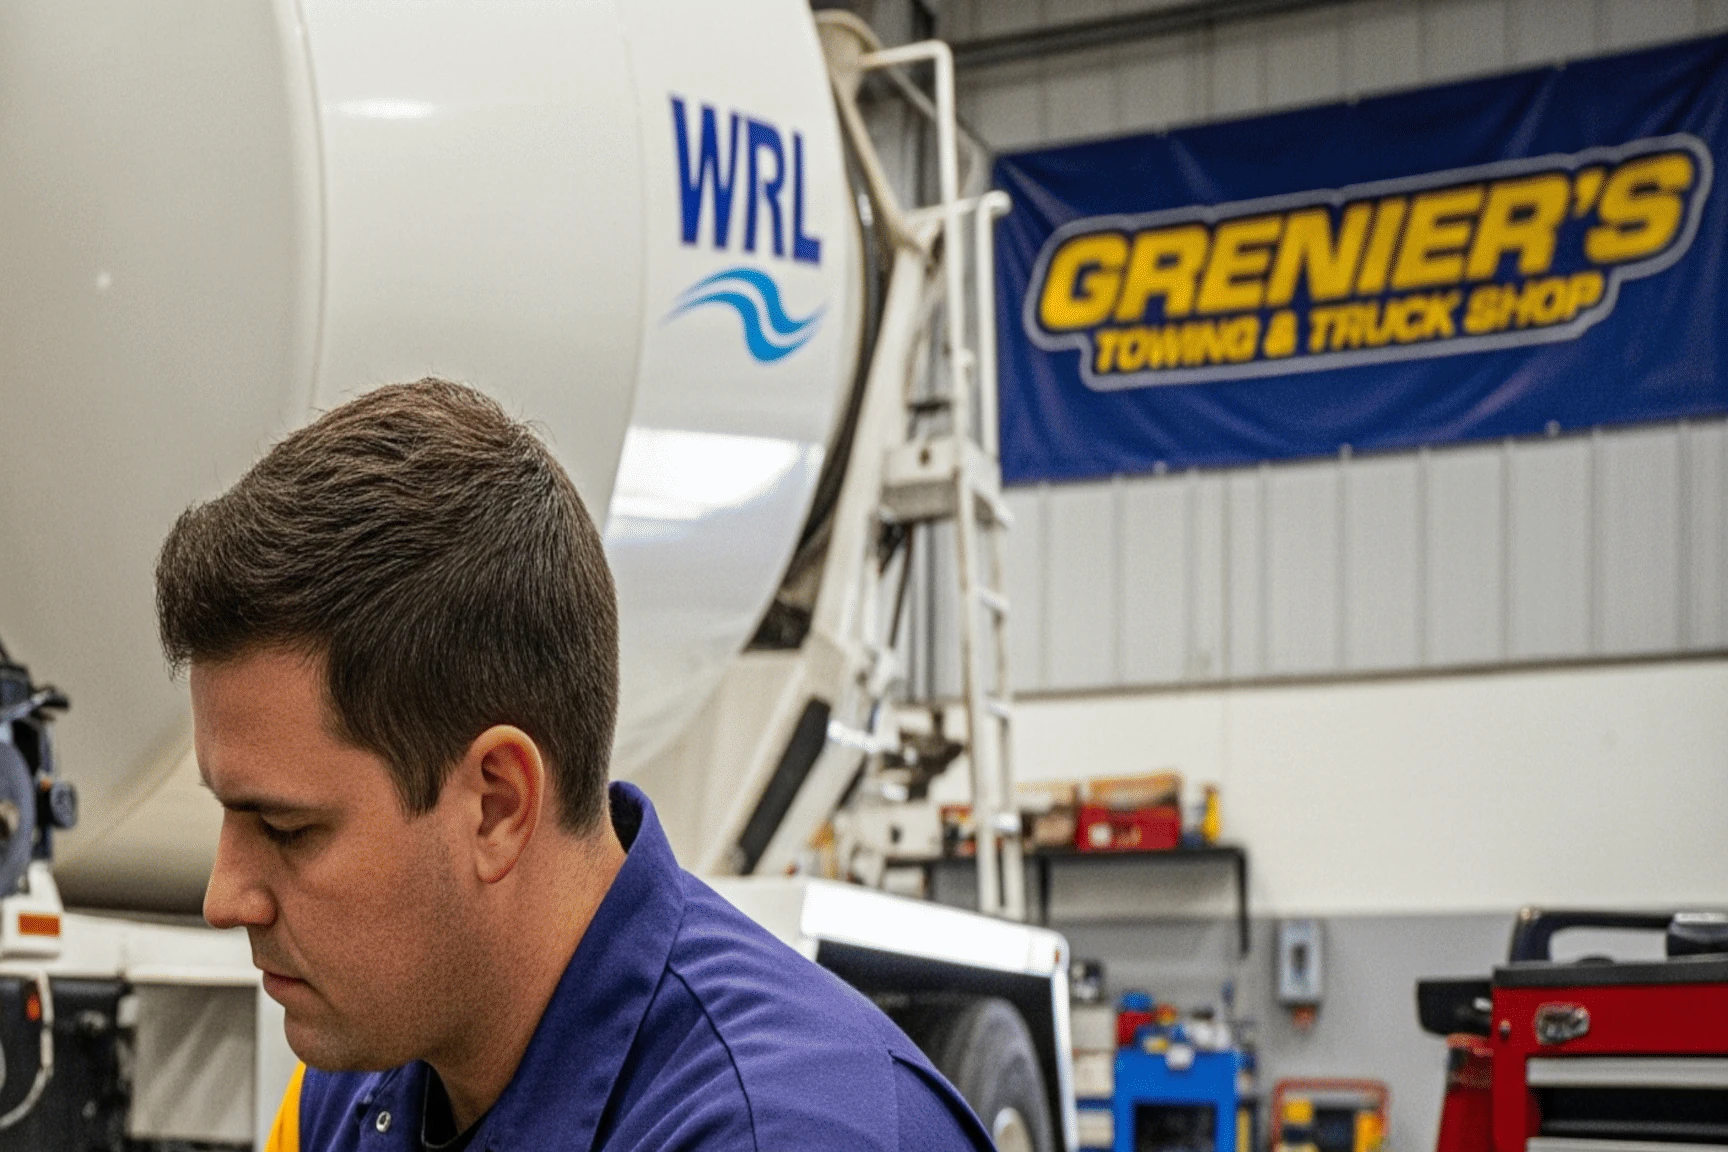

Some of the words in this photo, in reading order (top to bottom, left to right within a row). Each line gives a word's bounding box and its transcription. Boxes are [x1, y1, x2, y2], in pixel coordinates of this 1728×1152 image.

[671, 97, 821, 264] WRL
[1037, 153, 1693, 331] GRENIER'S
[1095, 313, 1260, 375] TOWING
[1263, 311, 1298, 358] &
[1308, 296, 1461, 354] TRUCK
[1464, 271, 1604, 335] SHOP
